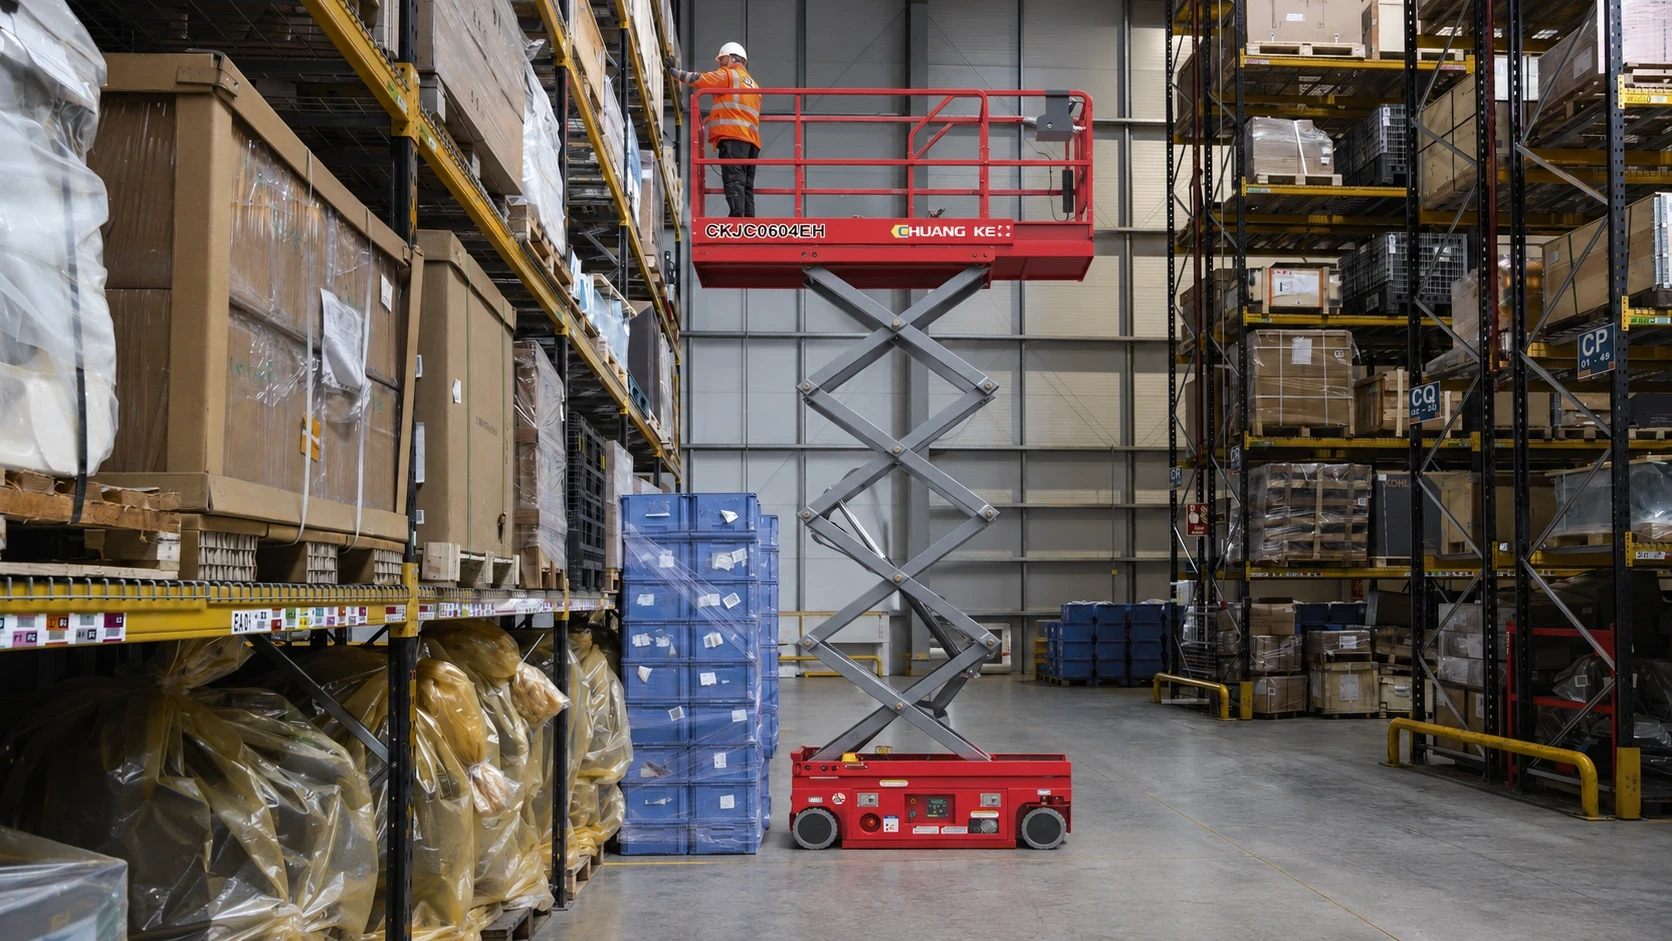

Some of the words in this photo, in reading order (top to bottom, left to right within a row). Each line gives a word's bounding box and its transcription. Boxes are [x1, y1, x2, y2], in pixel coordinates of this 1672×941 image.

[705, 223, 826, 238] CKJC0604EH
[893, 224, 966, 238] CHUANG
[1582, 329, 1608, 357] CP
[1581, 359, 1590, 368] 01
[1412, 384, 1436, 406] CQ
